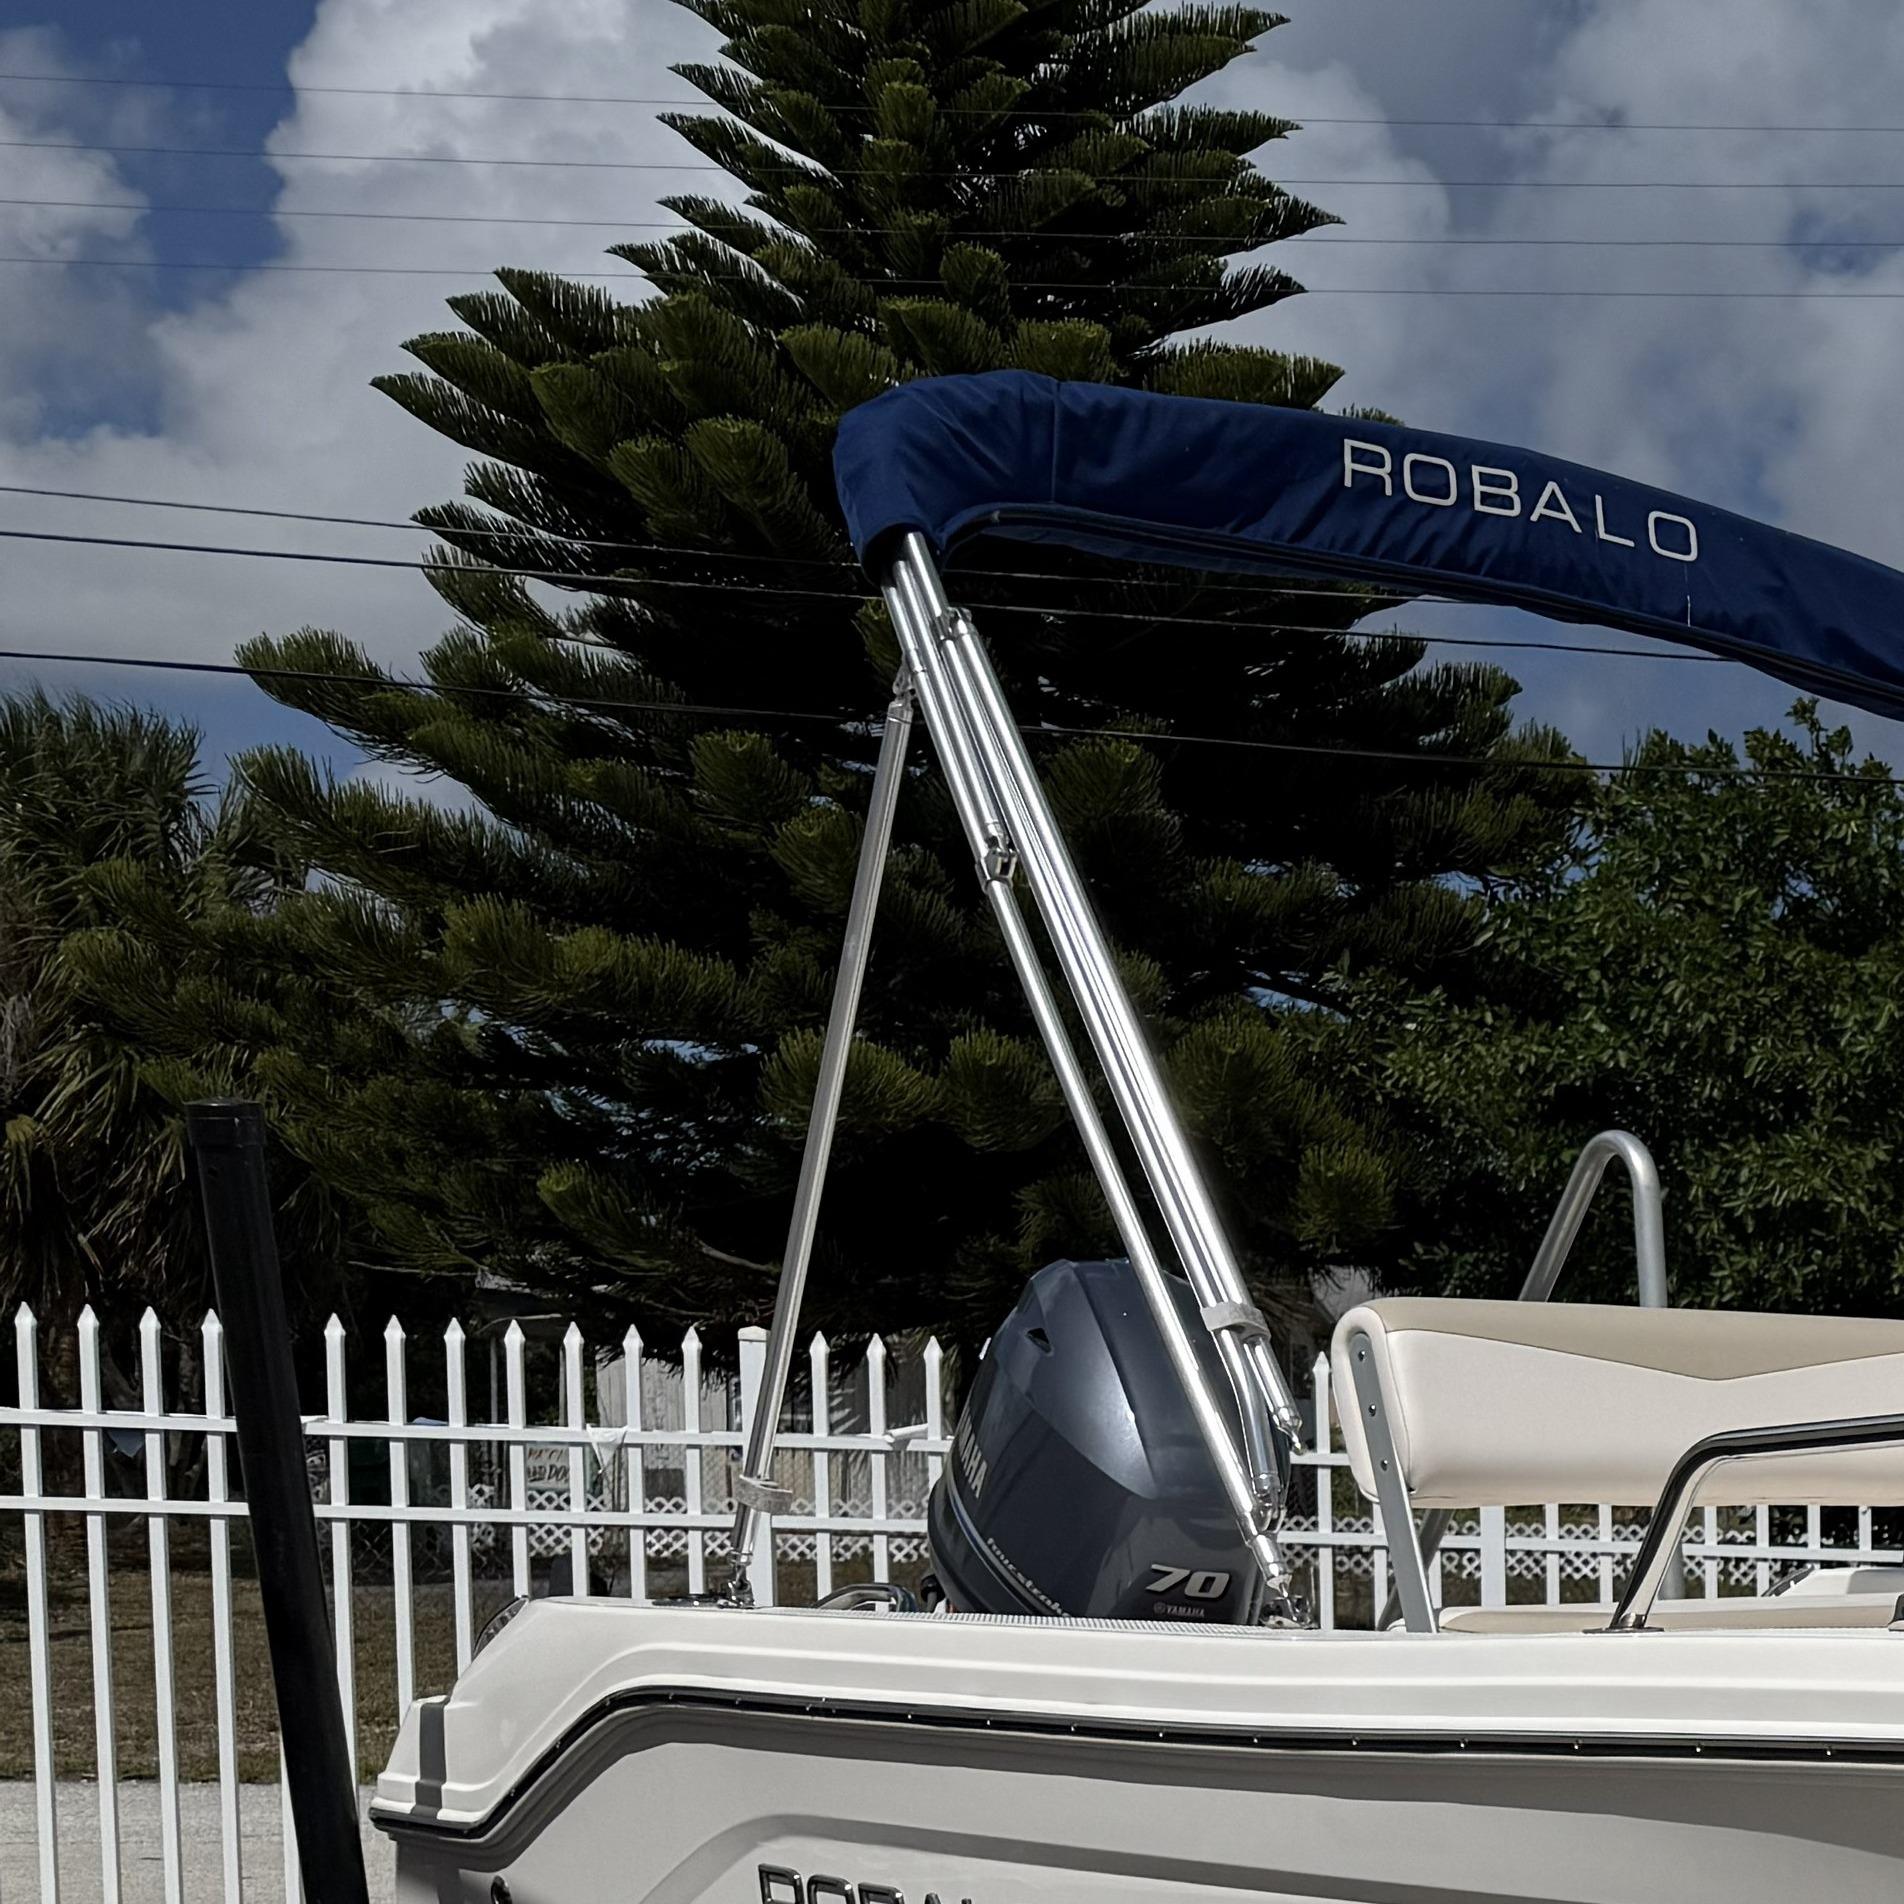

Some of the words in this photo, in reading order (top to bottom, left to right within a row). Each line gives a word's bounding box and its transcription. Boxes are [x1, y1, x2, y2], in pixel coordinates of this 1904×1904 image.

[1343, 437, 1699, 563] ROBALO
[1145, 1563, 1230, 1599] 70
[1166, 1604, 1205, 1618] YAMAHA
